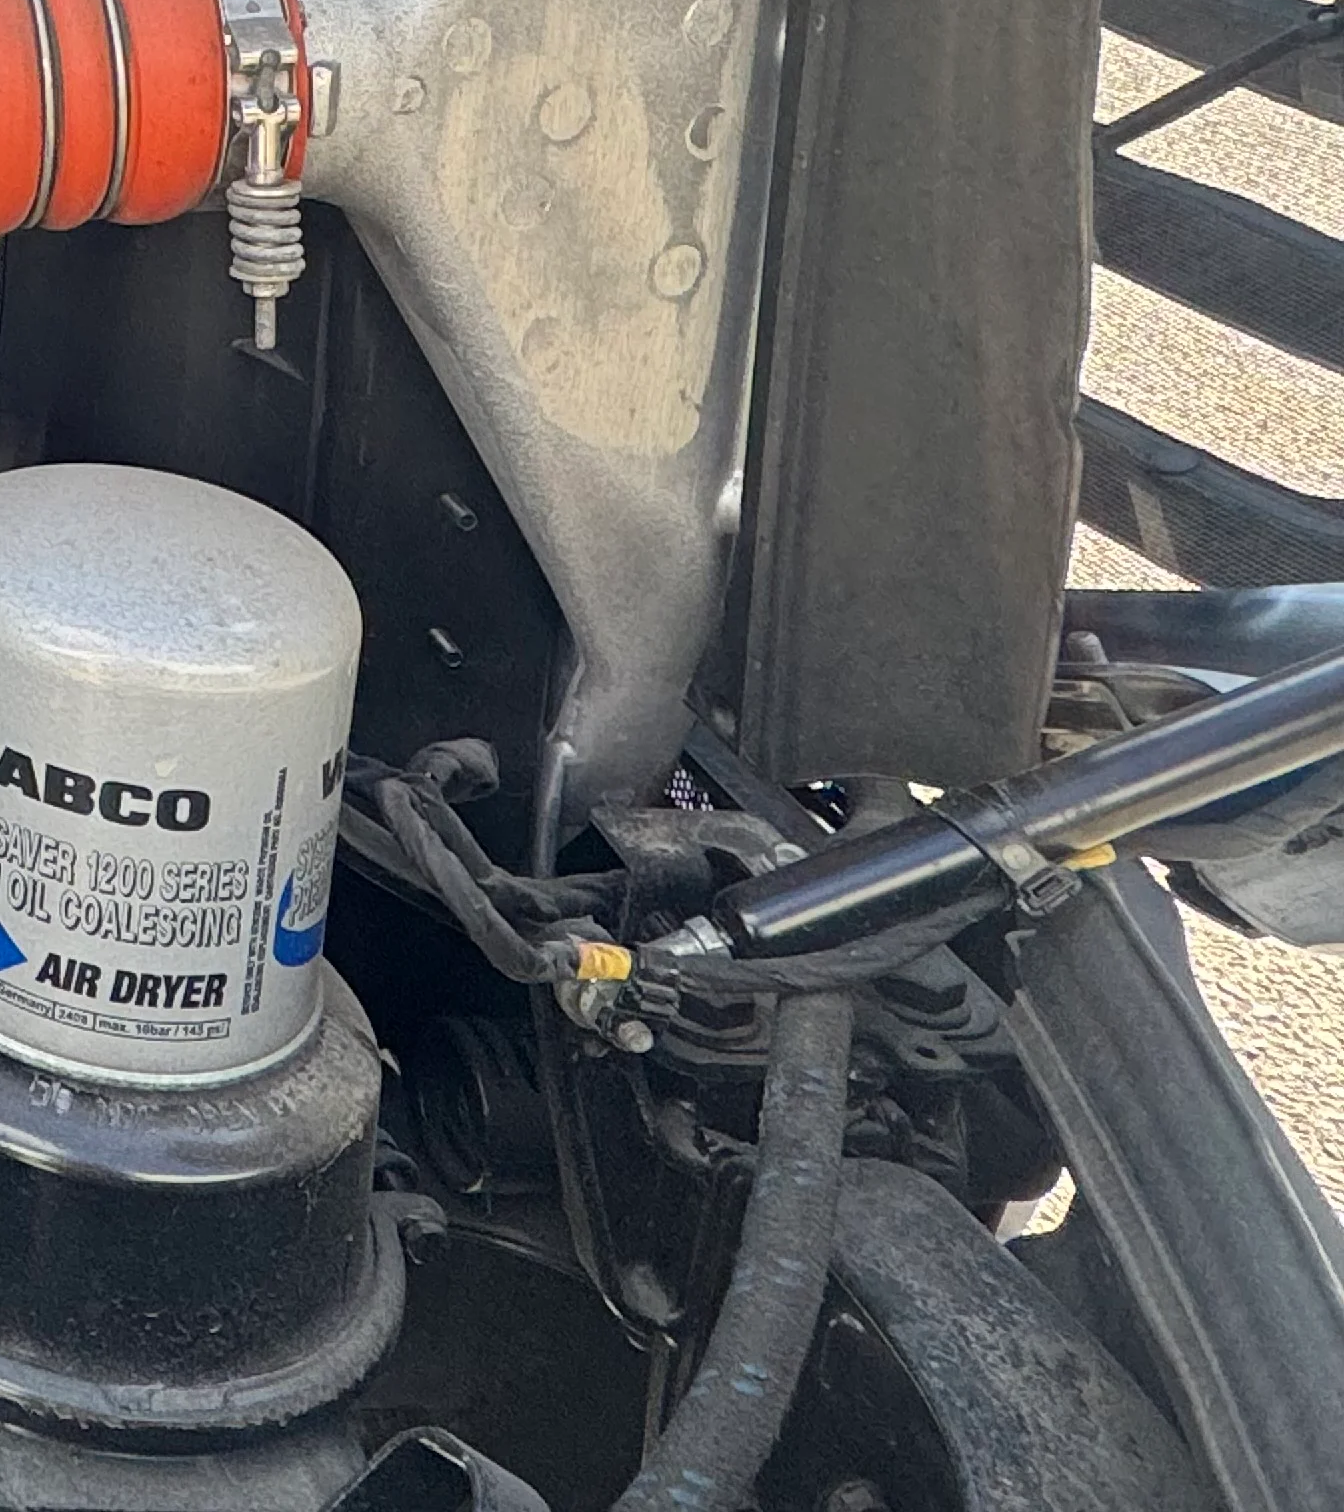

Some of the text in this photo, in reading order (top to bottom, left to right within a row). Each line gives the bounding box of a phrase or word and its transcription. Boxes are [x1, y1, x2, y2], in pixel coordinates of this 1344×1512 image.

[87, 848, 154, 900] 1200
[160, 859, 248, 903] SERIES
[7, 868, 52, 924] OIL
[59, 887, 242, 949] COALESCING
[35, 952, 228, 1009] AIR DRYER
[99, 1019, 127, 1034] max.
